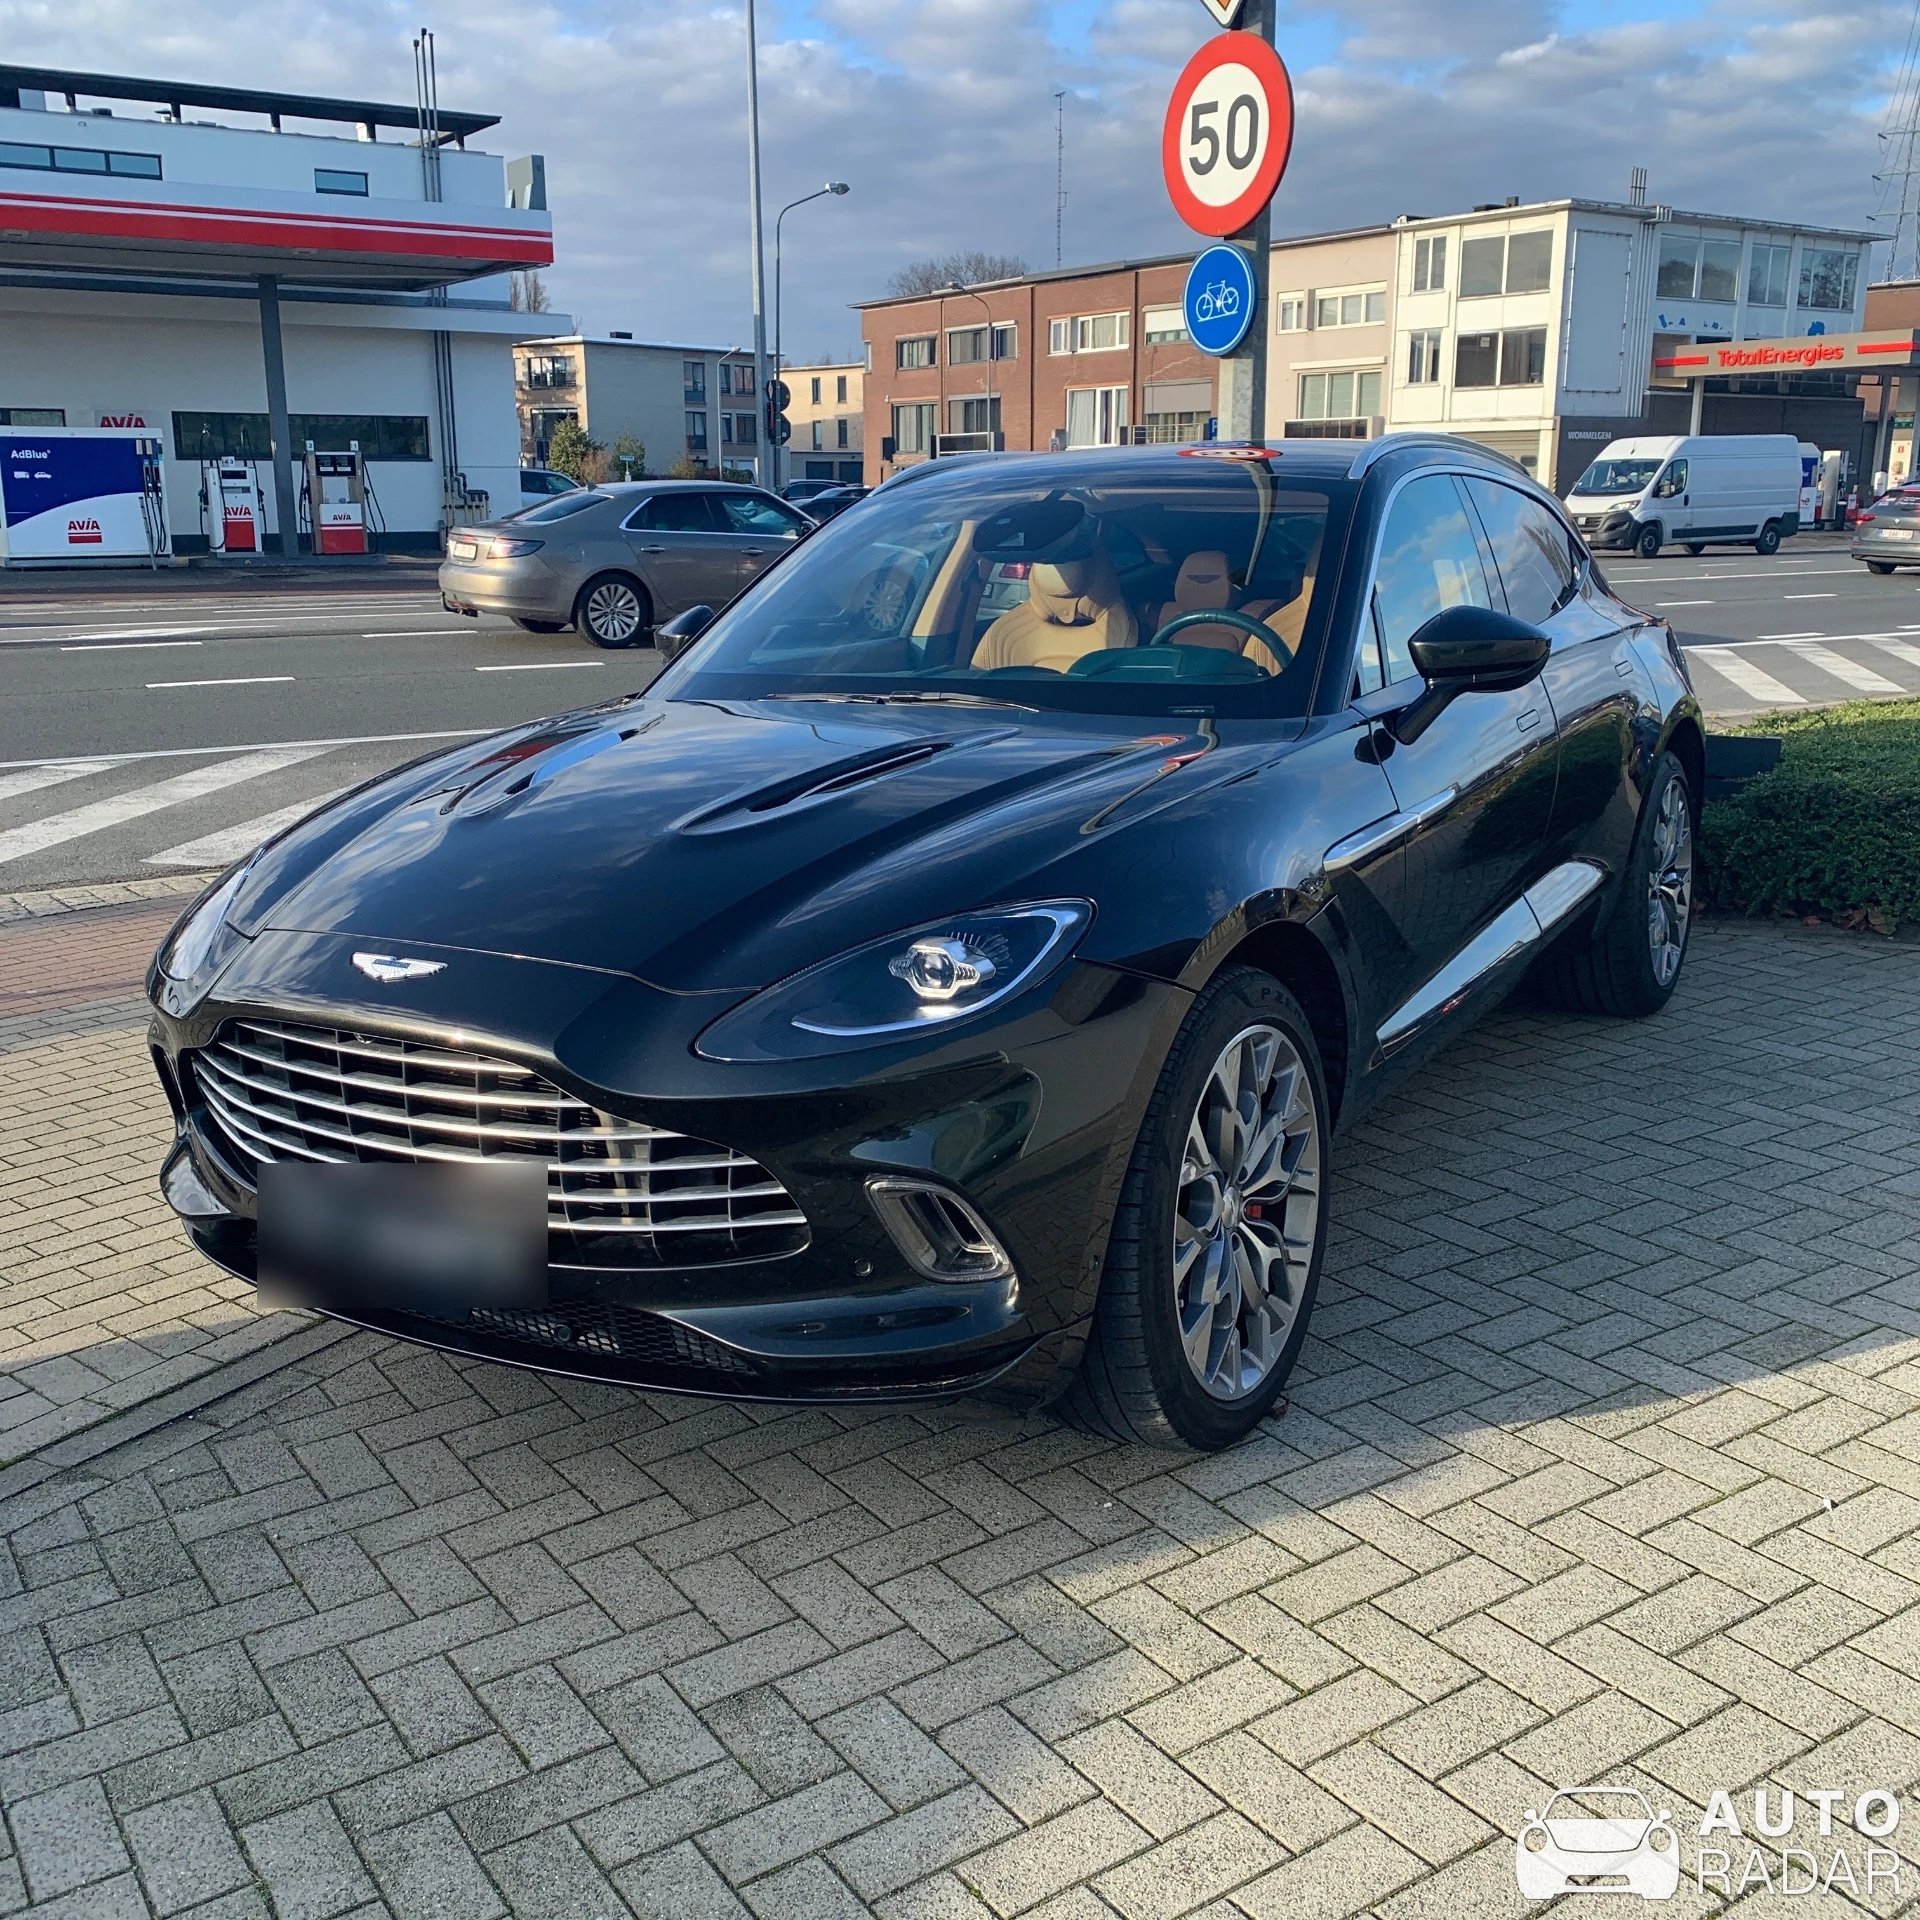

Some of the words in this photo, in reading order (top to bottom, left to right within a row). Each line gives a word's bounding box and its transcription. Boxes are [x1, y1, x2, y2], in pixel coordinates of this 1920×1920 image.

[1189, 94, 1259, 176] 50
[1718, 342, 1844, 367] TotalEnergies
[100, 413, 146, 428] AVIA
[1568, 431, 1612, 440] WOMMELGEM
[224, 504, 251, 516] AVIA
[333, 512, 351, 521] AVIA
[68, 518, 100, 531] AVIA
